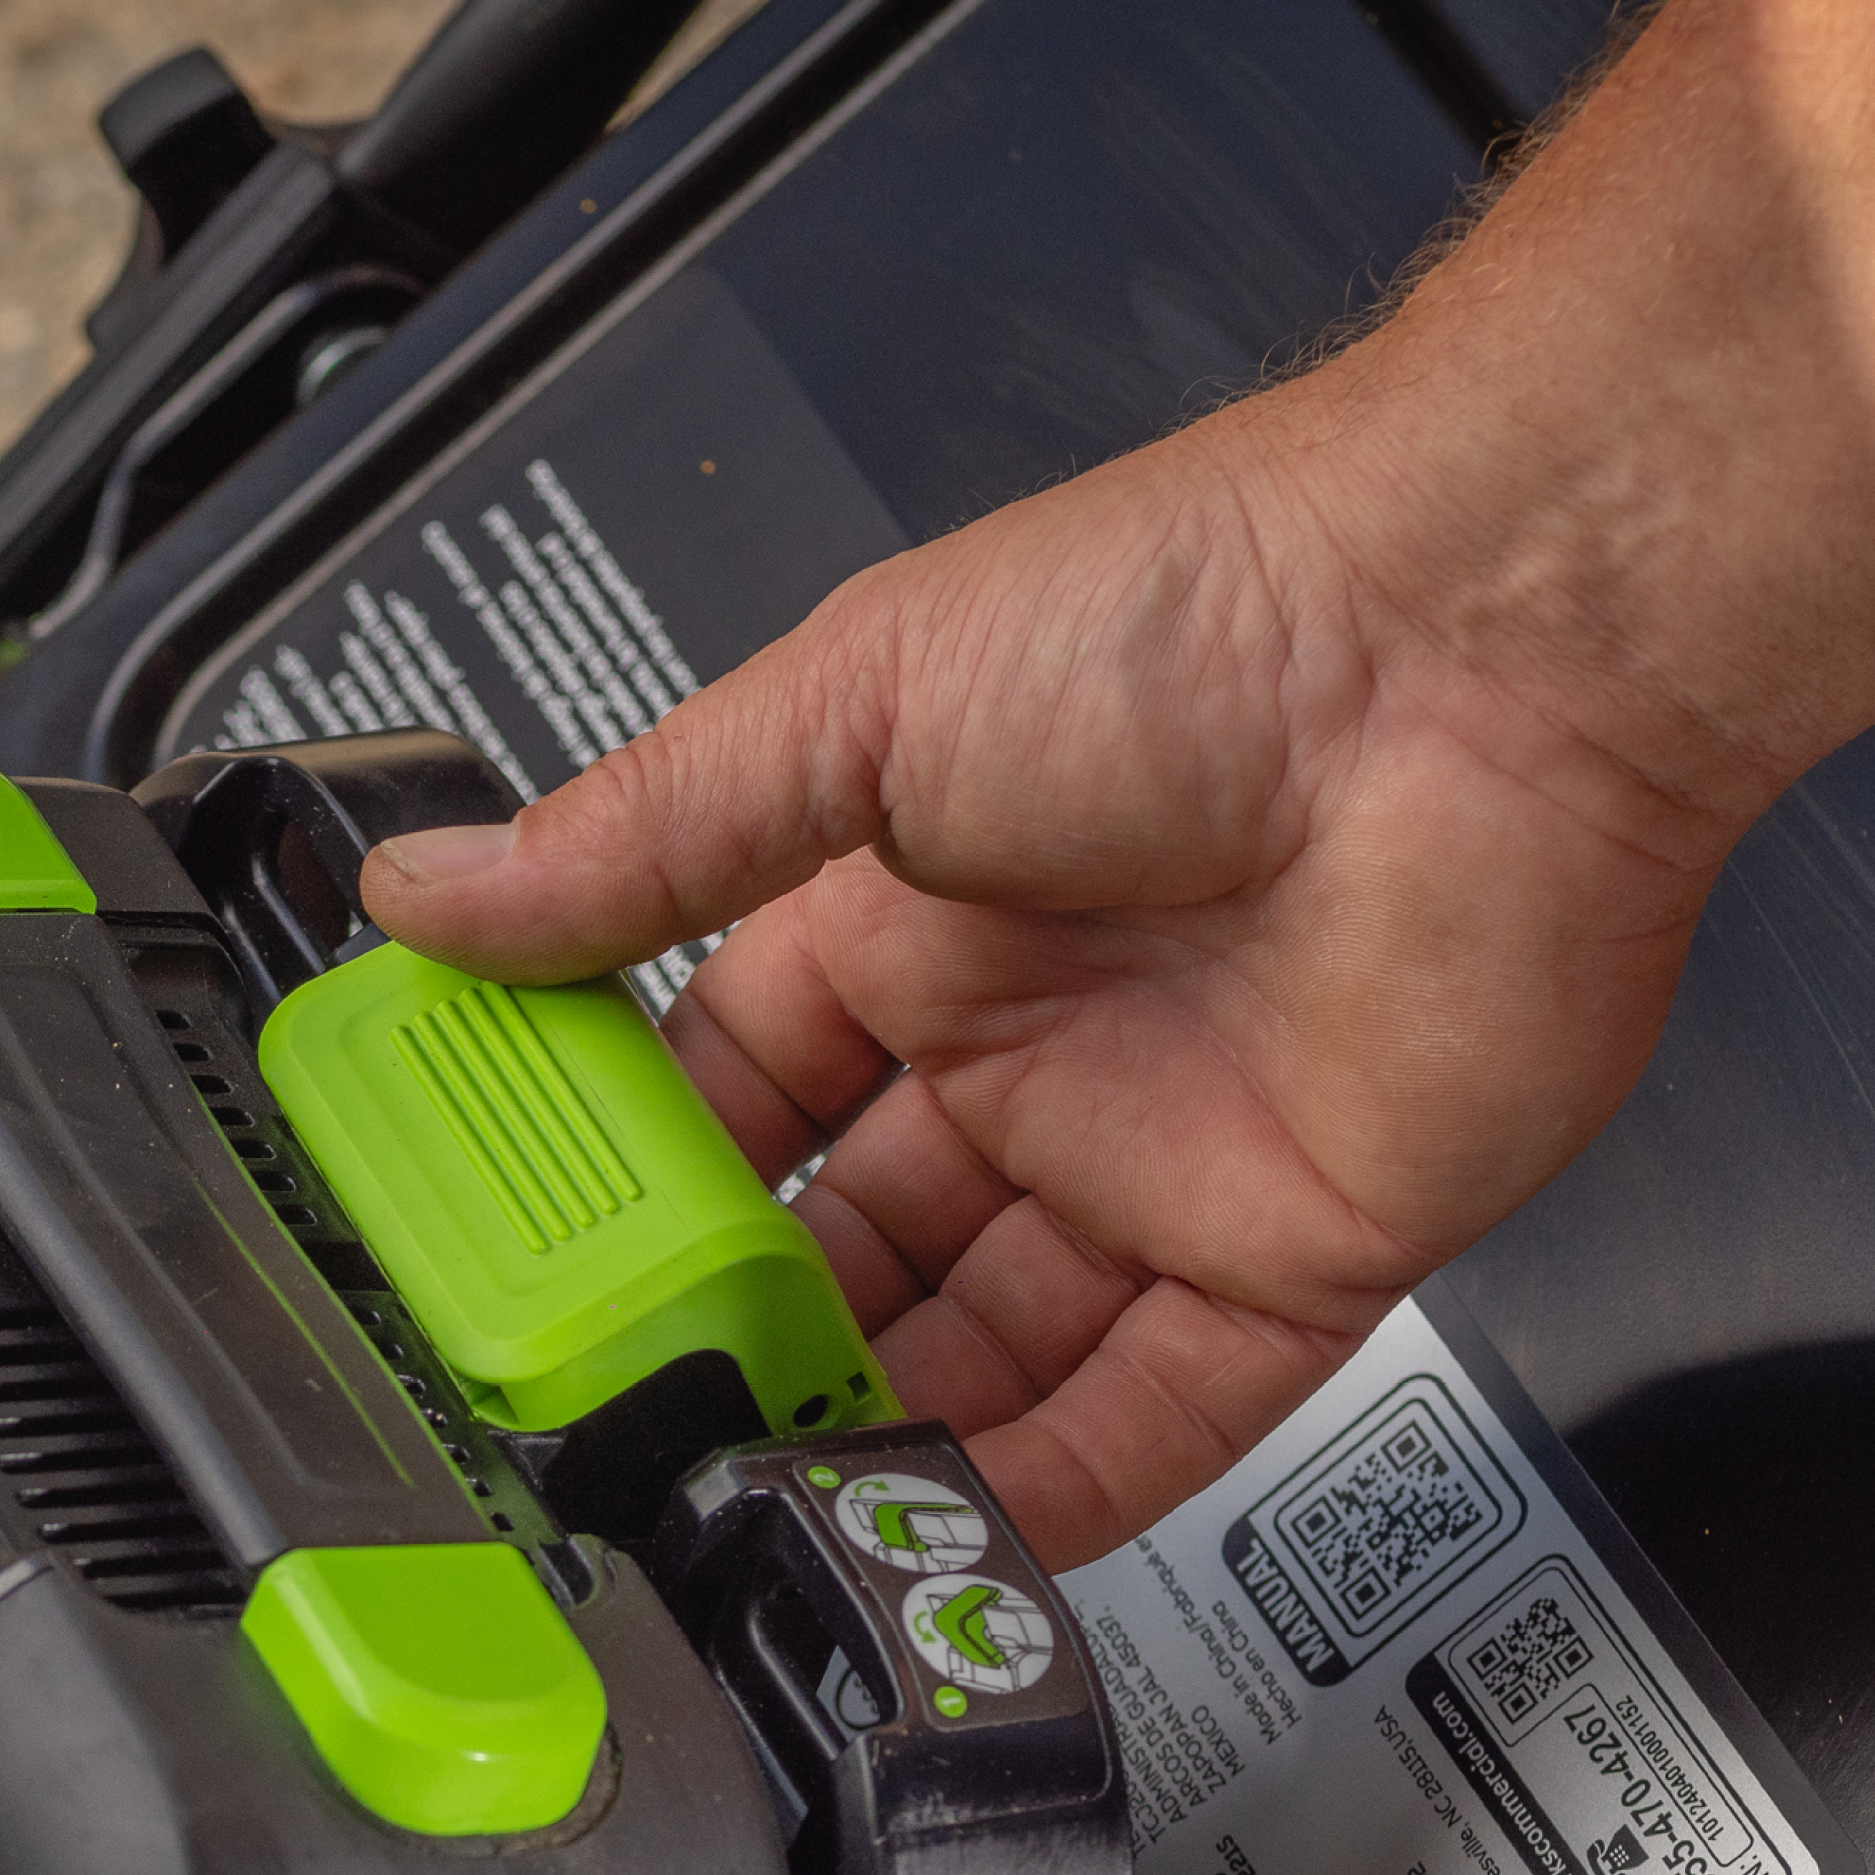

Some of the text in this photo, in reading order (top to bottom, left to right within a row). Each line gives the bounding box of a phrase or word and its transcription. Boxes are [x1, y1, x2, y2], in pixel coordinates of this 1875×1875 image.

[1235, 1536, 1334, 1672] MANUAL
[1135, 1666, 1168, 1706] JAL
[1211, 1599, 1301, 1728] Hecho en China
[1232, 1674, 1250, 1696] in
[1135, 1716, 1164, 1747] DE
[1158, 1701, 1226, 1794] ZAPOPAN
[1189, 1705, 1245, 1776] MEXICO
[1244, 1692, 1282, 1744] Made
[1154, 1744, 1207, 1805] ARCOS
[1615, 1693, 1723, 1840] 1012404010001152
[1432, 1794, 1462, 1828] NC
